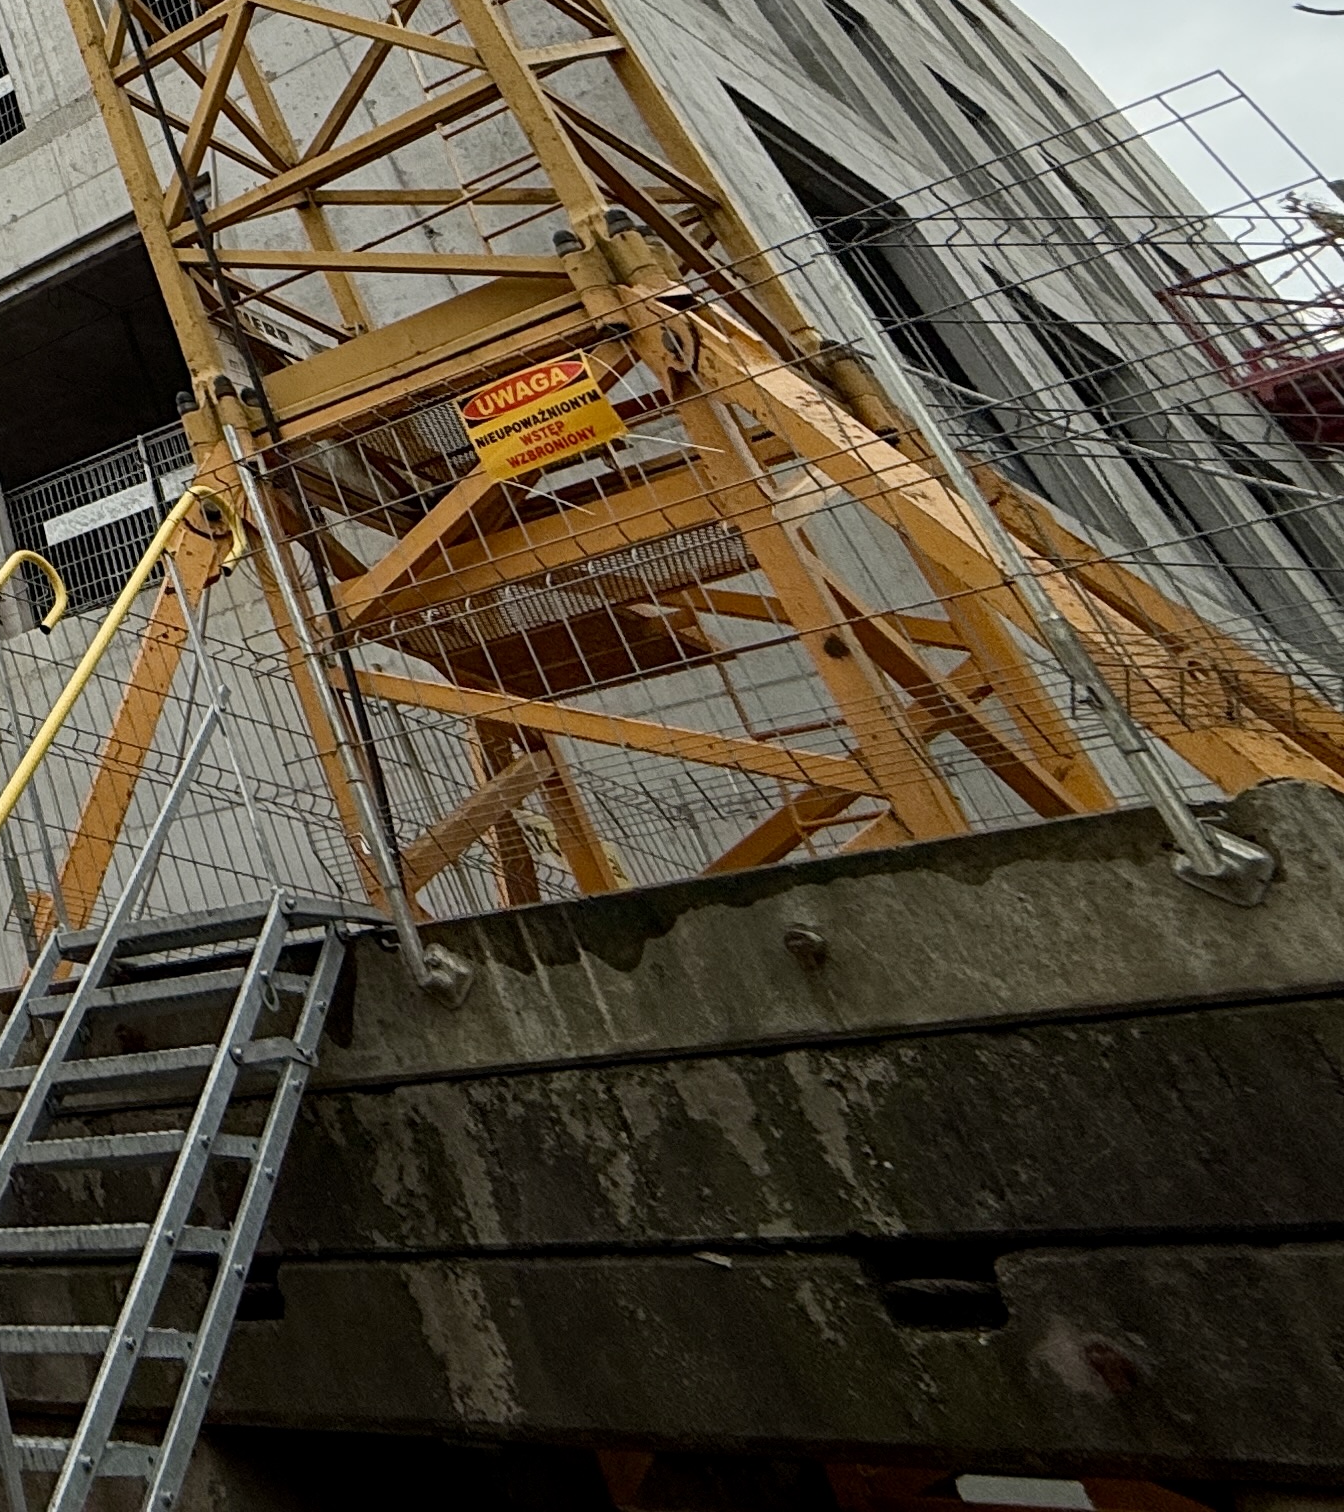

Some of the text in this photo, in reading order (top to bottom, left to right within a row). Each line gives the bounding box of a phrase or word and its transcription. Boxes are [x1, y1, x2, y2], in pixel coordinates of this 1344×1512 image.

[474, 366, 570, 416] UWAGA
[474, 388, 602, 449] NIEUPOWAŻNIONYM
[518, 419, 566, 446] WSTĘP
[505, 425, 597, 469] WZBRONIONY
